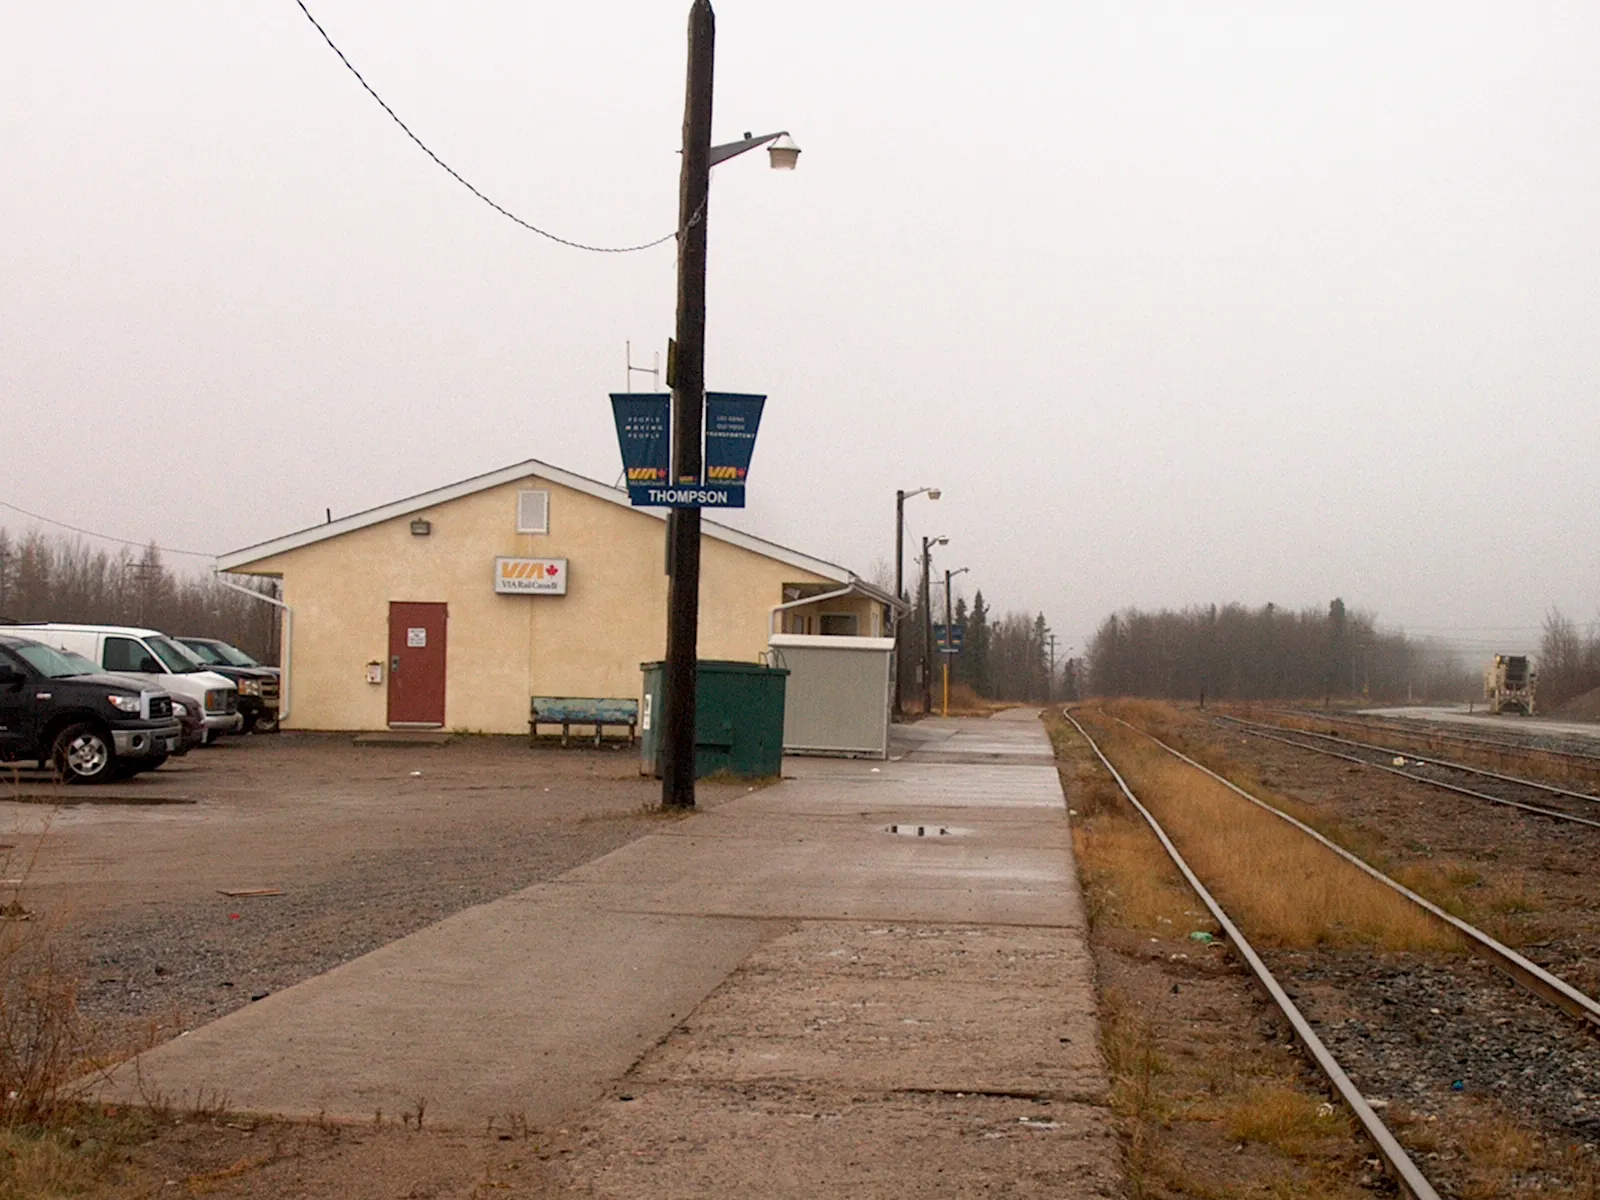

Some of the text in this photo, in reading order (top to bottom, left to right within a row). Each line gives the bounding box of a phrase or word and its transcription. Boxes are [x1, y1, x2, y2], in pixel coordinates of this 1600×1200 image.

[628, 468, 657, 480] VIA
[708, 466, 737, 479] VIA
[648, 489, 728, 503] THOMPSON
[502, 563, 544, 579] VIA
[501, 580, 517, 588] VIA
[532, 581, 558, 589] Canada
